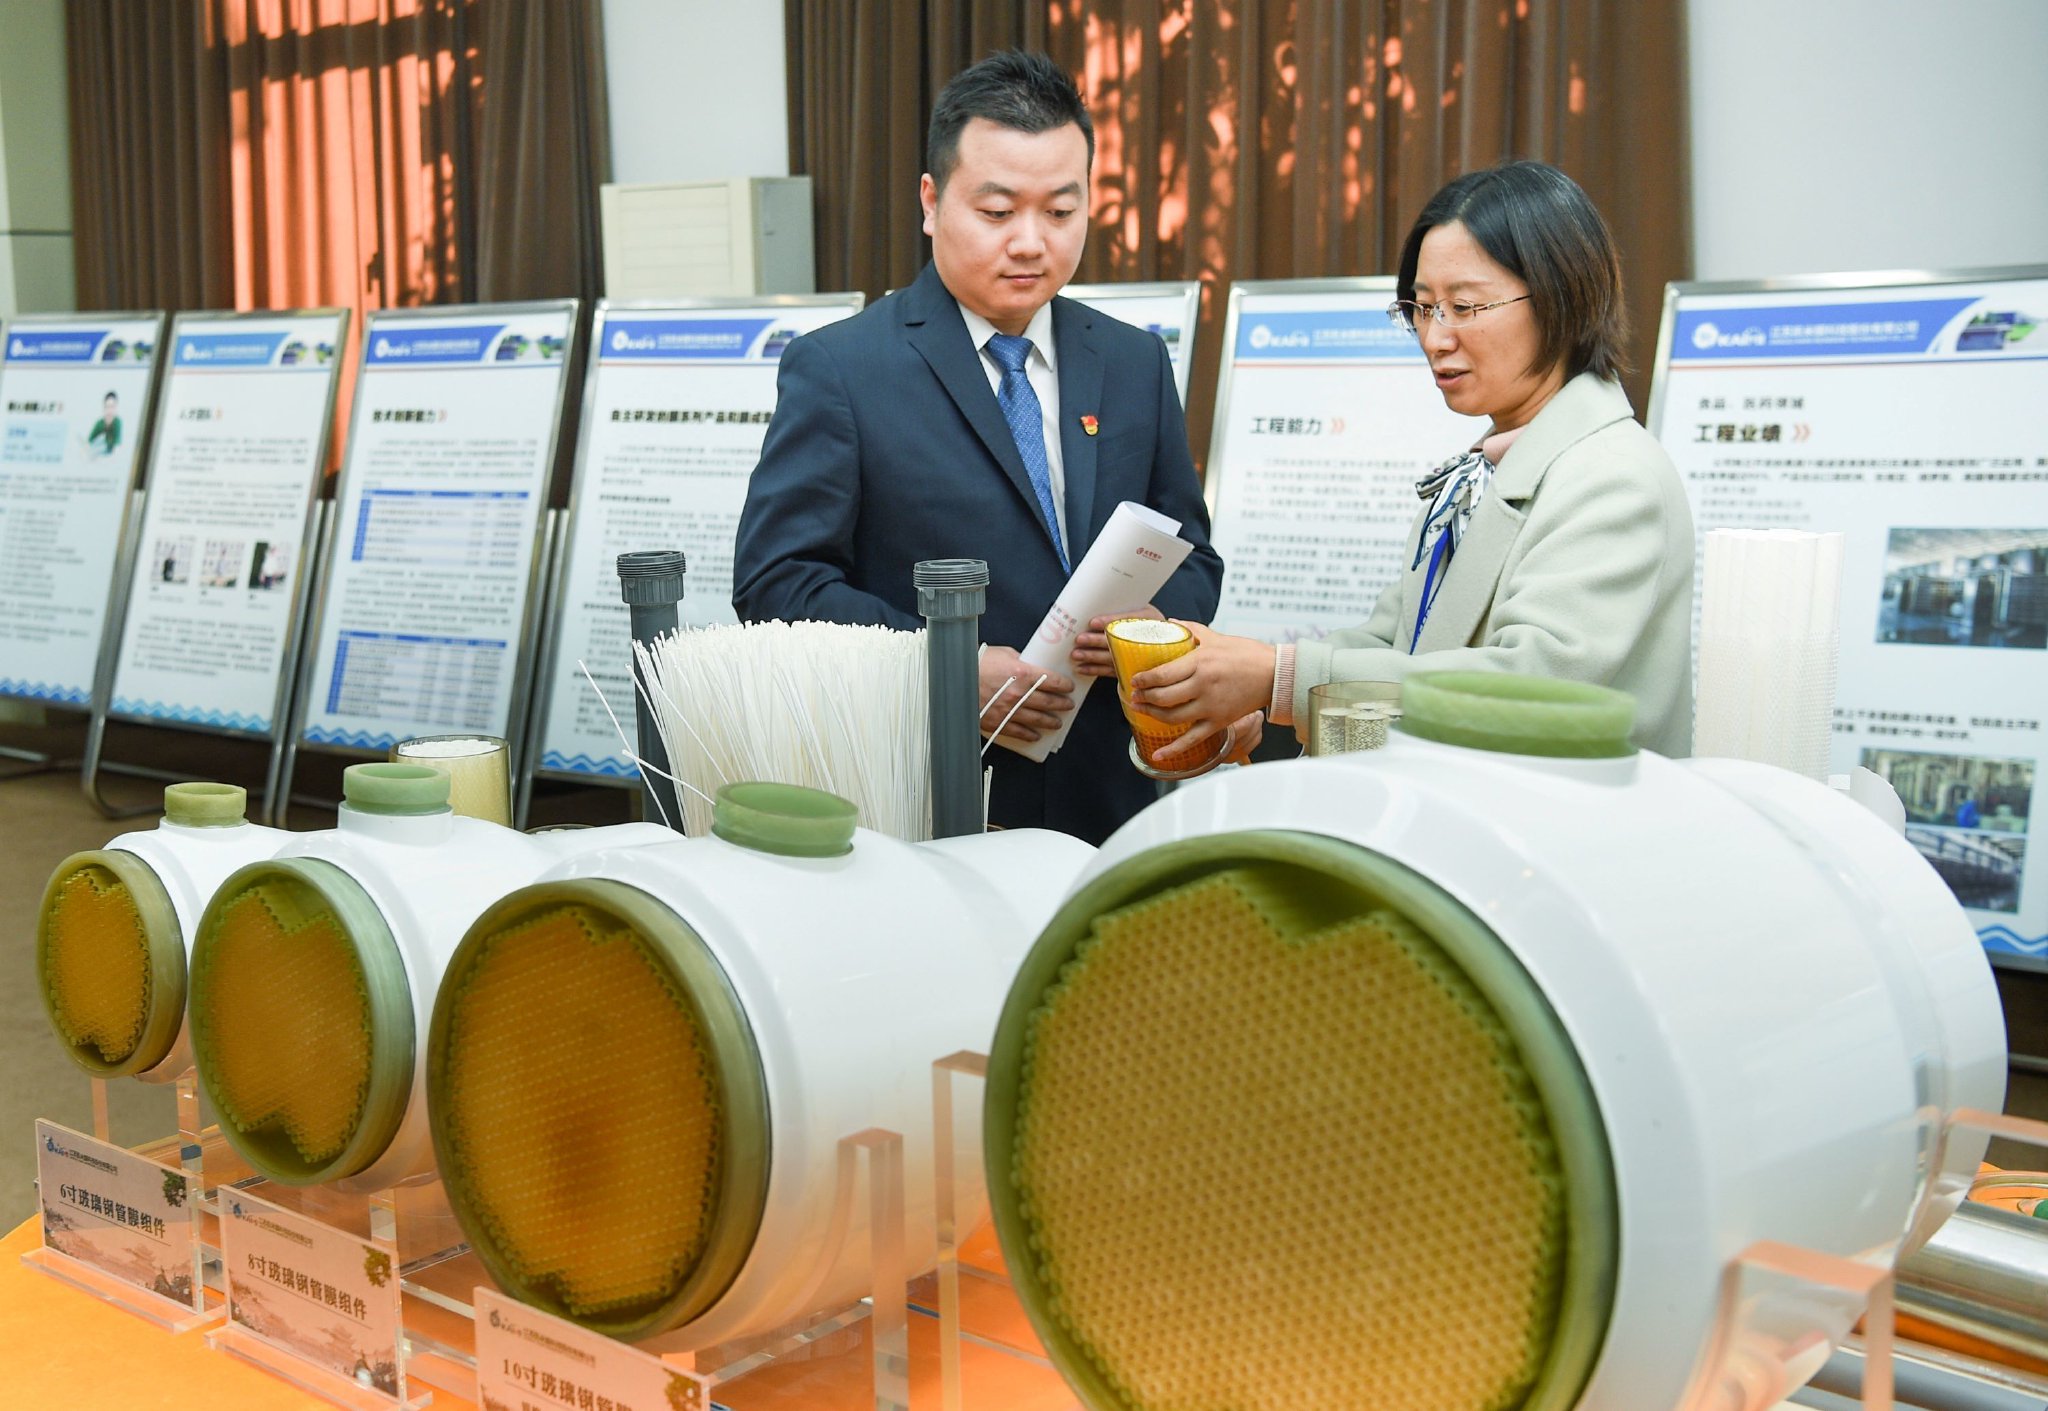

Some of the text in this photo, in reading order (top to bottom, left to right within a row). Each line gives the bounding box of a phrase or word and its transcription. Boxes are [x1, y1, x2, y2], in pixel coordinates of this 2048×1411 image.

[1250, 417, 1322, 436] 工程能力
[1693, 424, 1780, 442] 工程业绩
[60, 1183, 166, 1239] 6寸玻璃钢管膜组件
[248, 1253, 367, 1320] 8寸玻璃钢管膜组件
